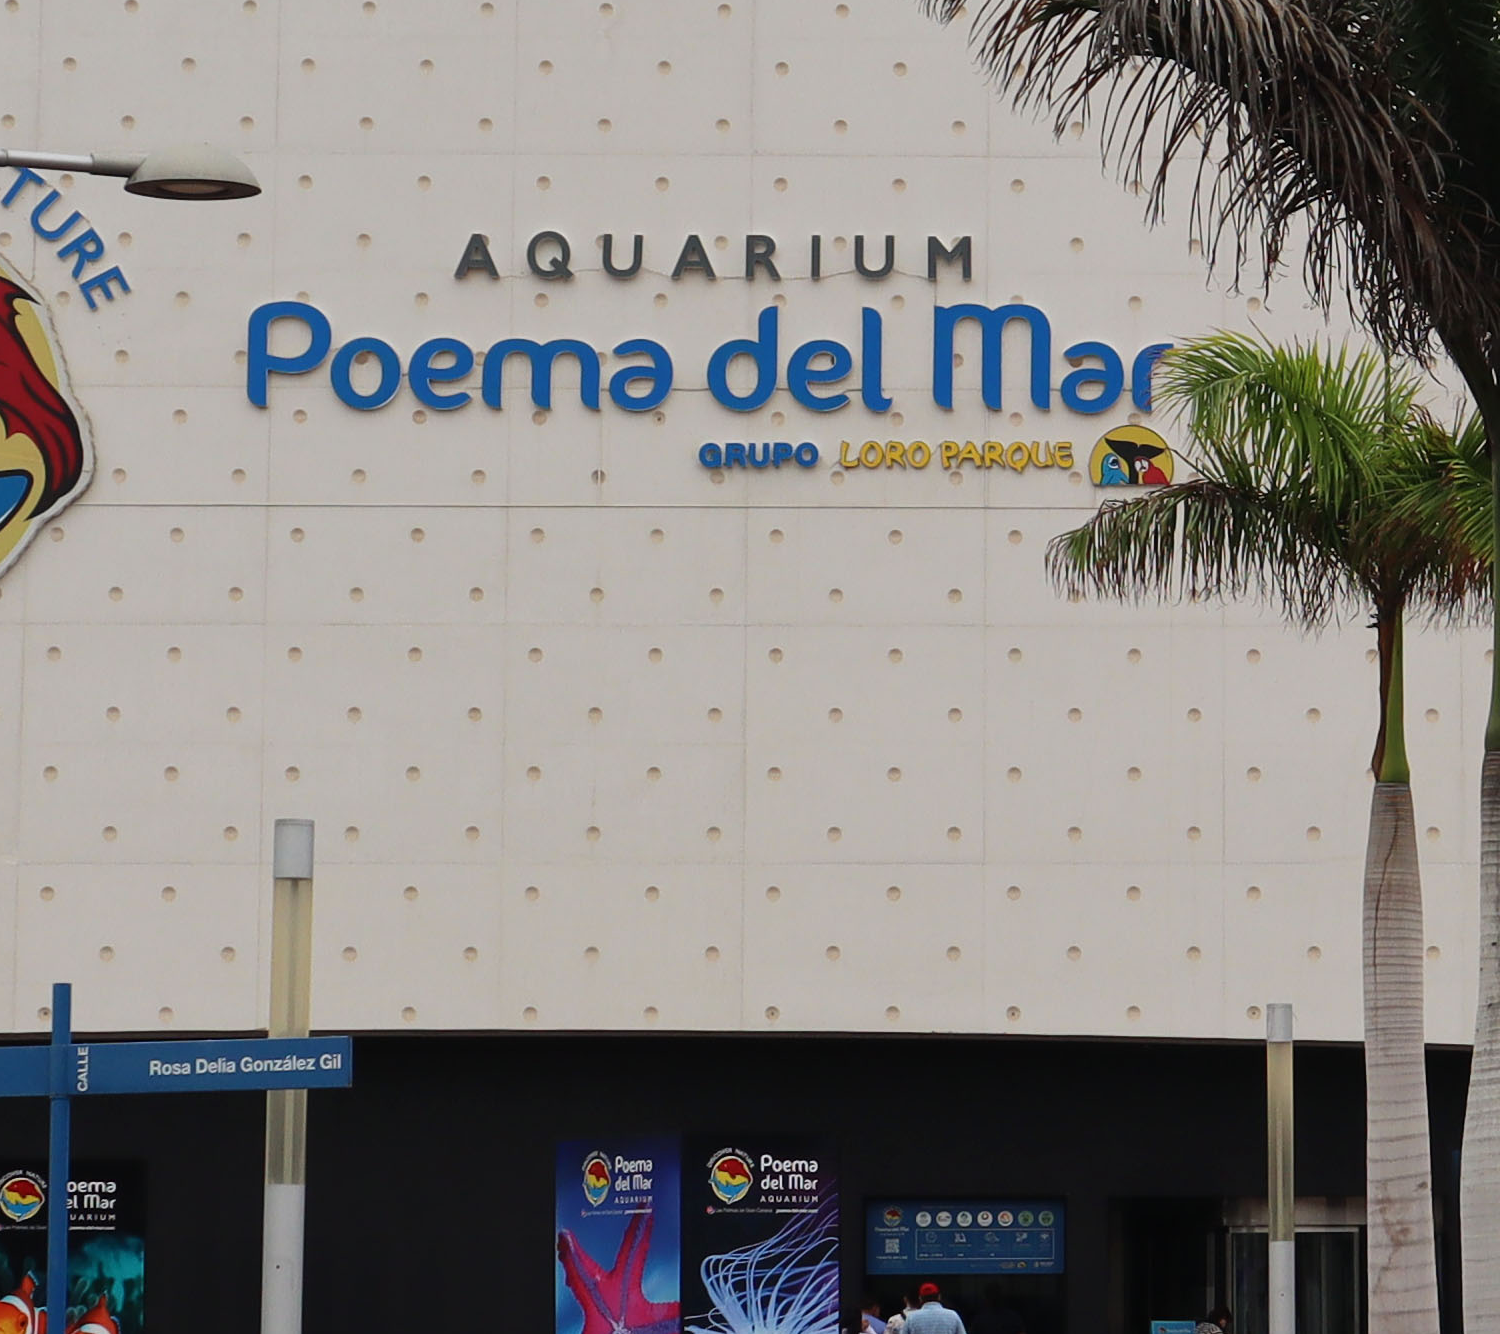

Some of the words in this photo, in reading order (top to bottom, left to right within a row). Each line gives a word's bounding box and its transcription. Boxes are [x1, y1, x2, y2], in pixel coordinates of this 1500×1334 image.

[454, 230, 974, 282] AQUARIUM
[246, 300, 675, 412] Poema
[705, 305, 893, 414] del
[933, 302, 1174, 414] Mar
[699, 442, 820, 469] GRUPO
[839, 440, 932, 470] LORO
[940, 440, 1075, 475] PARQUE
[76, 1046, 90, 1092] CALLE
[149, 1059, 191, 1077] Rosa
[195, 1057, 236, 1075] Delia
[240, 1054, 316, 1073] González
[319, 1053, 343, 1070] Gil
[614, 1155, 653, 1174] Poema
[760, 1154, 819, 1173] Poema
[67, 1180, 117, 1193] oema
[614, 1175, 630, 1192] del
[632, 1173, 653, 1191] Mar
[760, 1174, 785, 1190] del
[788, 1173, 819, 1190] Mar
[66, 1194, 78, 1209] el
[83, 1193, 117, 1209] Mar
[759, 1195, 819, 1203] AQUARIUM
[69, 1213, 116, 1221] UARIUM
